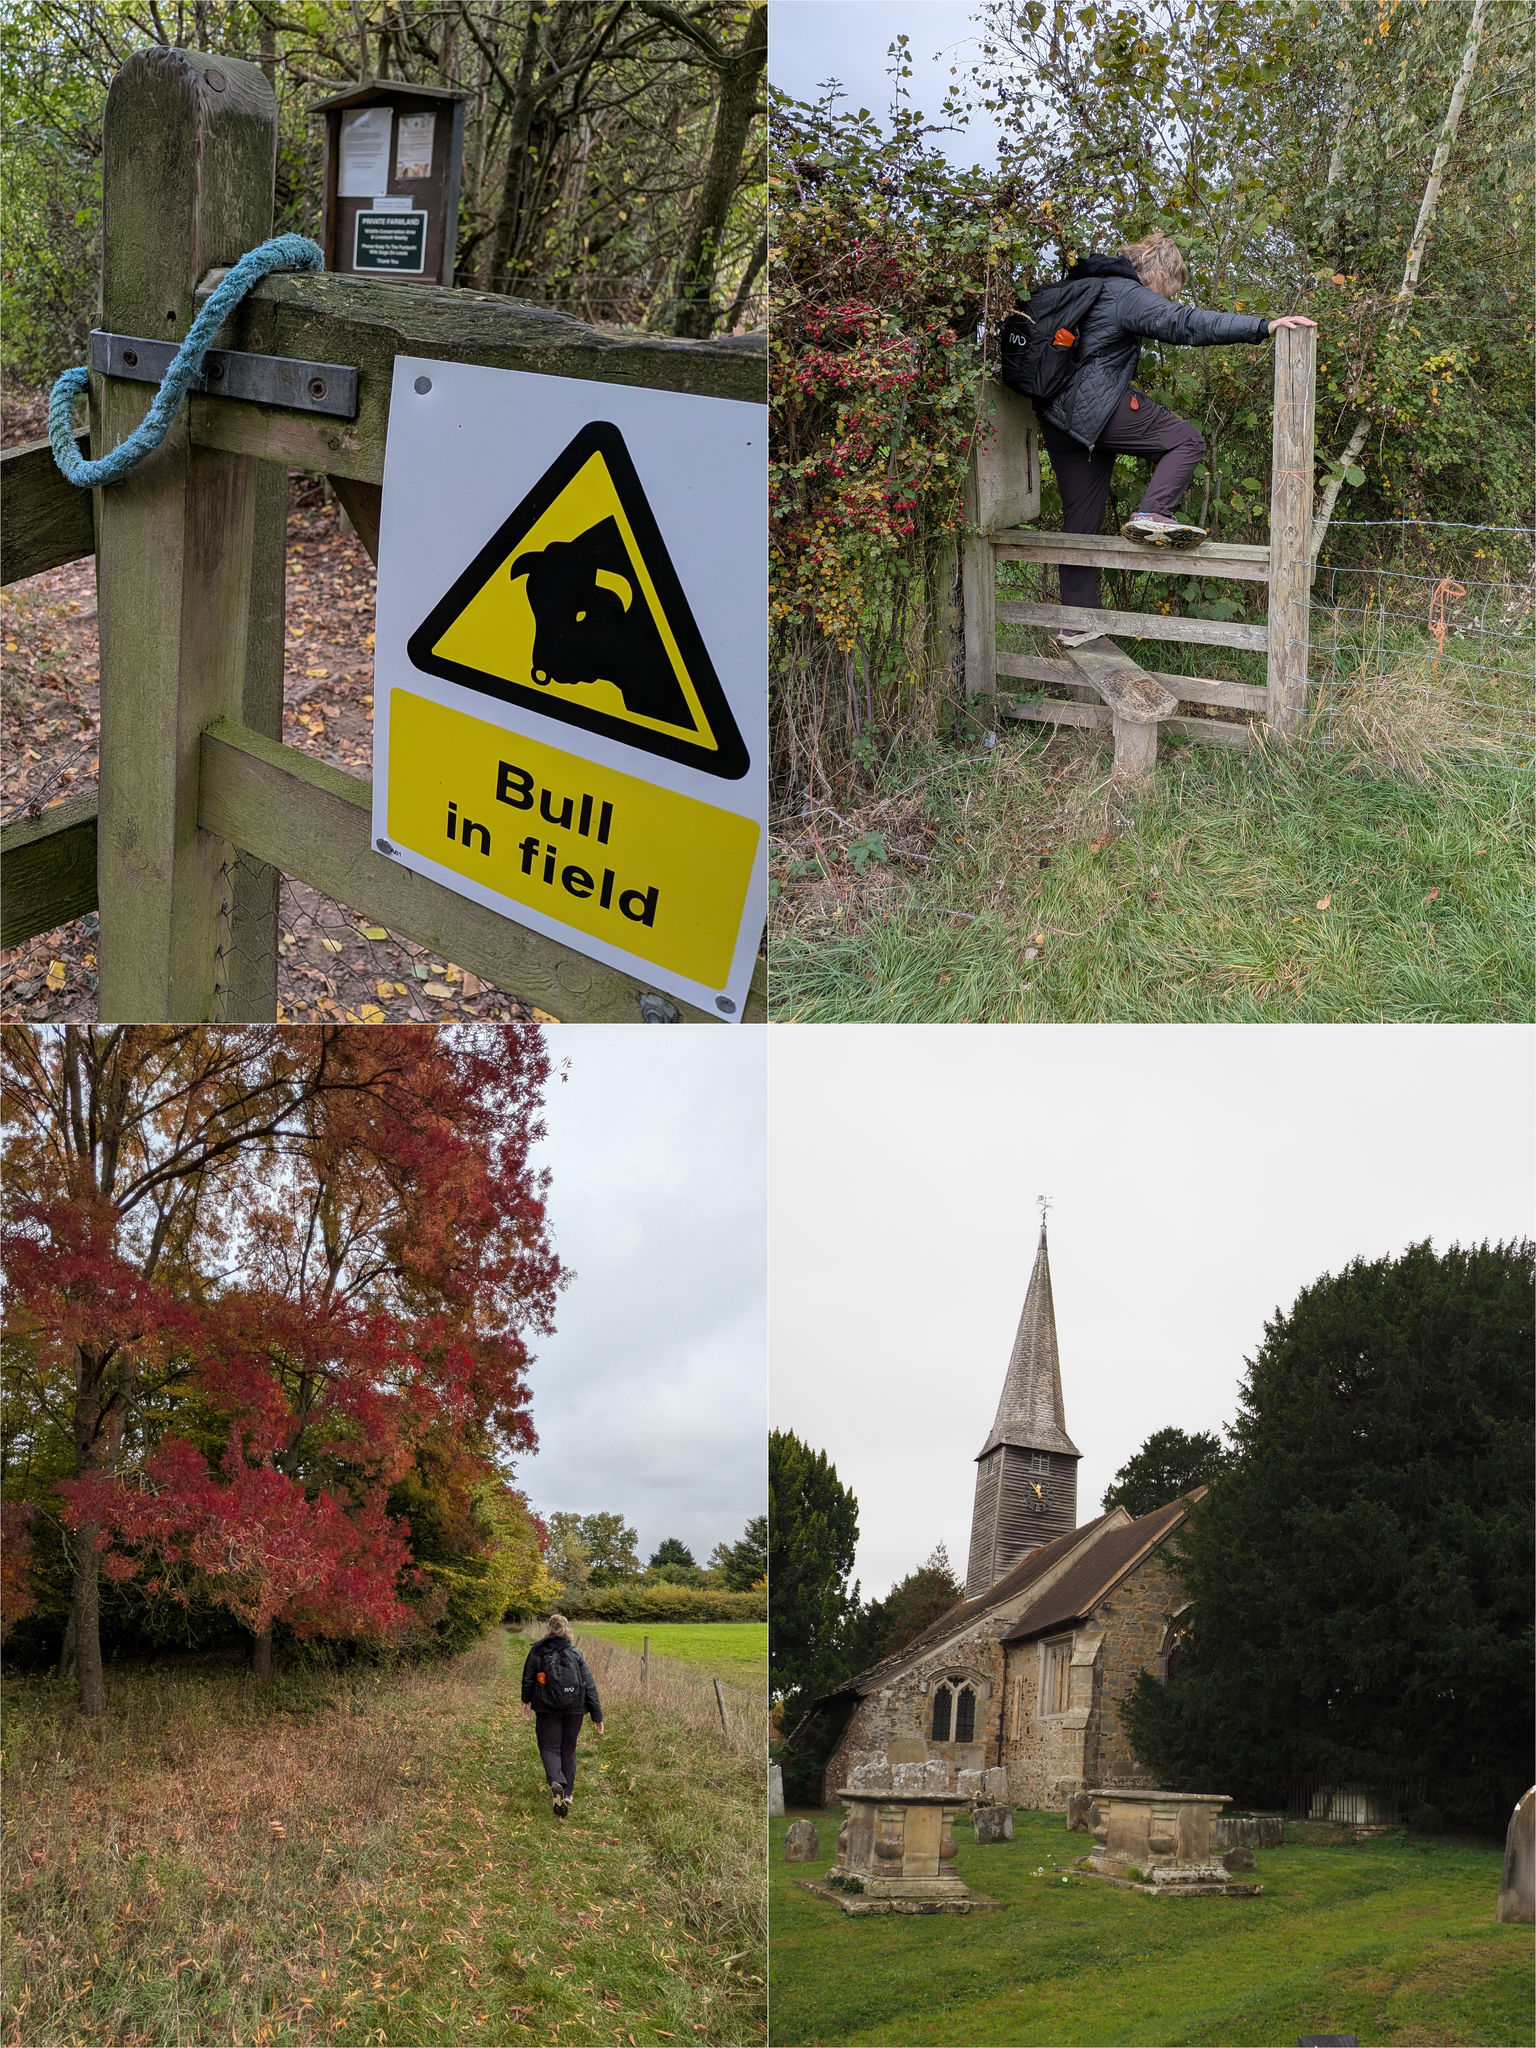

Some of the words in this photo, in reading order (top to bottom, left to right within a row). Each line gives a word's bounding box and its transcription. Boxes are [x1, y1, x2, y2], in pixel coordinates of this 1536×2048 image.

[362, 217, 386, 225] PRIVATE
[387, 217, 420, 226] FARMLAND
[496, 760, 613, 845] Bull
[446, 801, 491, 857] in
[518, 836, 660, 928] field
